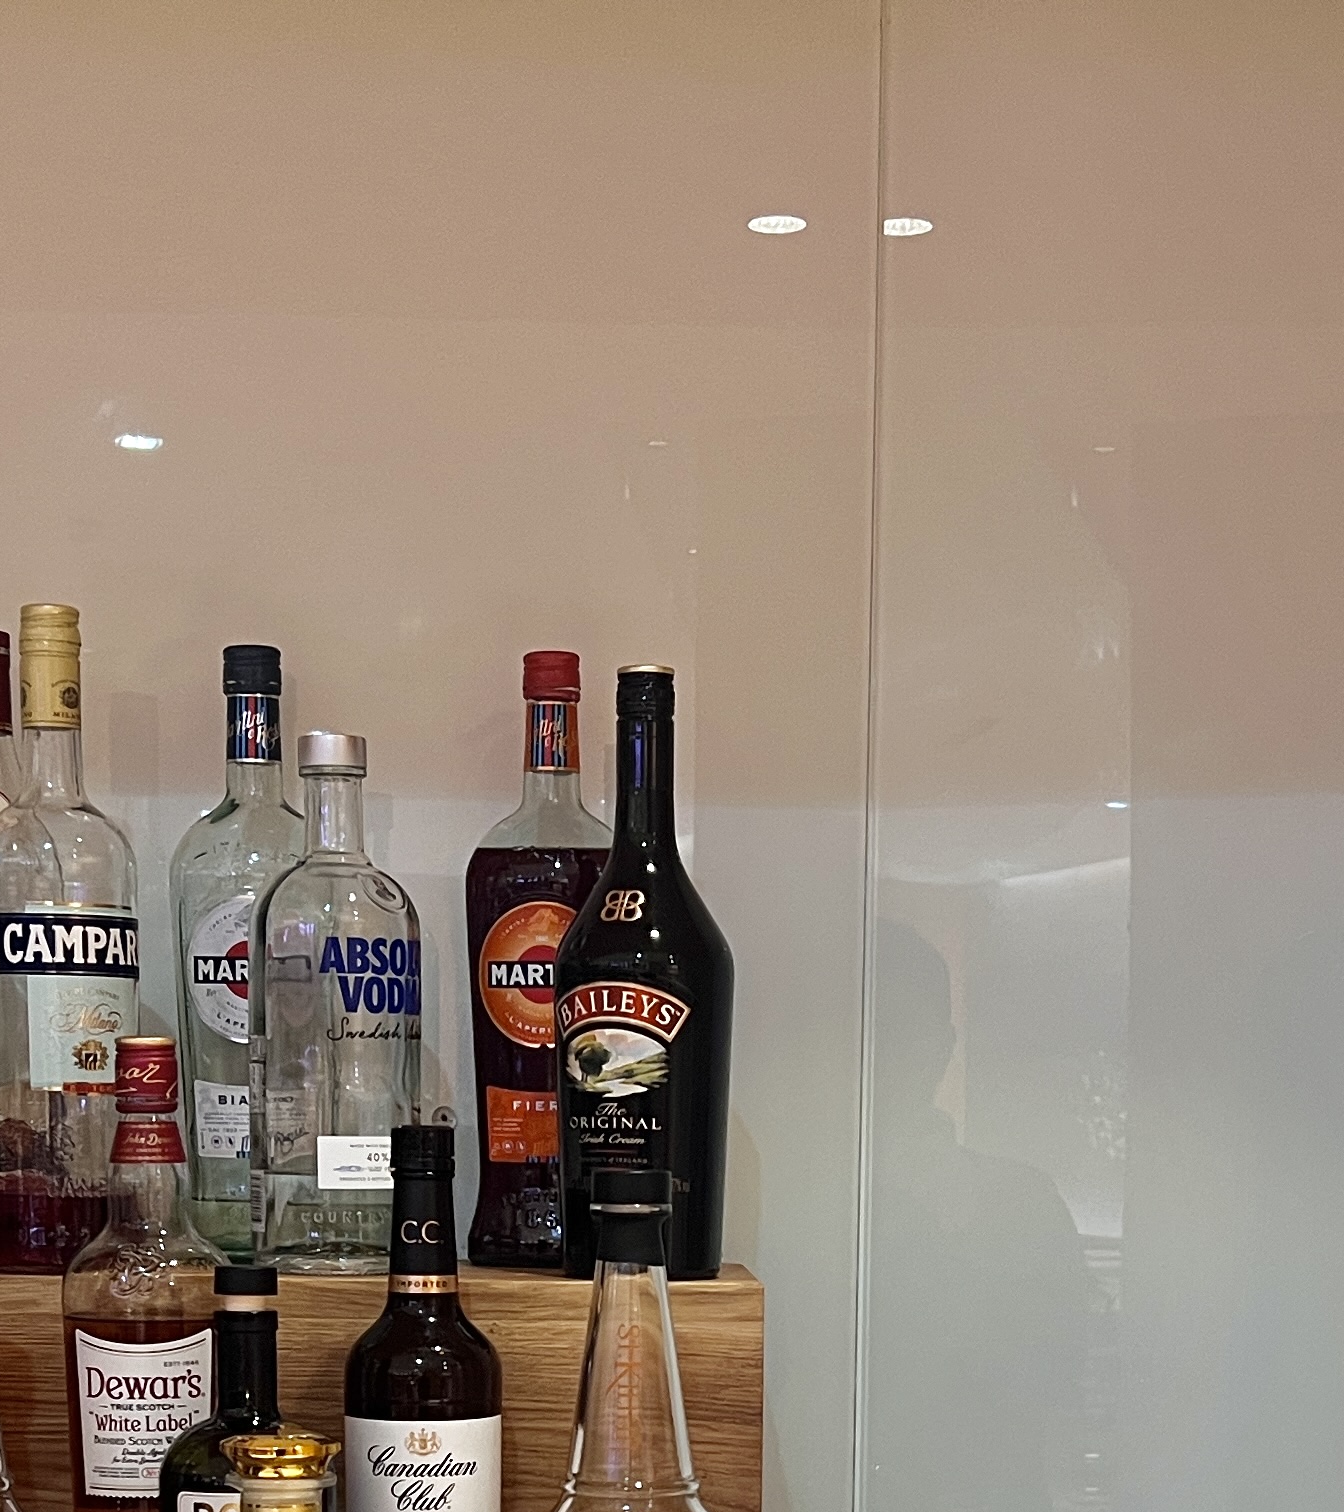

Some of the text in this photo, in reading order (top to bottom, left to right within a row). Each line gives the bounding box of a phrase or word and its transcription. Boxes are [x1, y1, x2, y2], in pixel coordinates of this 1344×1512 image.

[560, 989, 676, 1027] BAILEYS
[326, 1016, 402, 1042] Swedish
[569, 1116, 662, 1131] ORIGINAL
[85, 1366, 204, 1401] Dewar's
[110, 1402, 175, 1411] TRUE SCOTCH
[367, 1444, 478, 1478] Canadian
